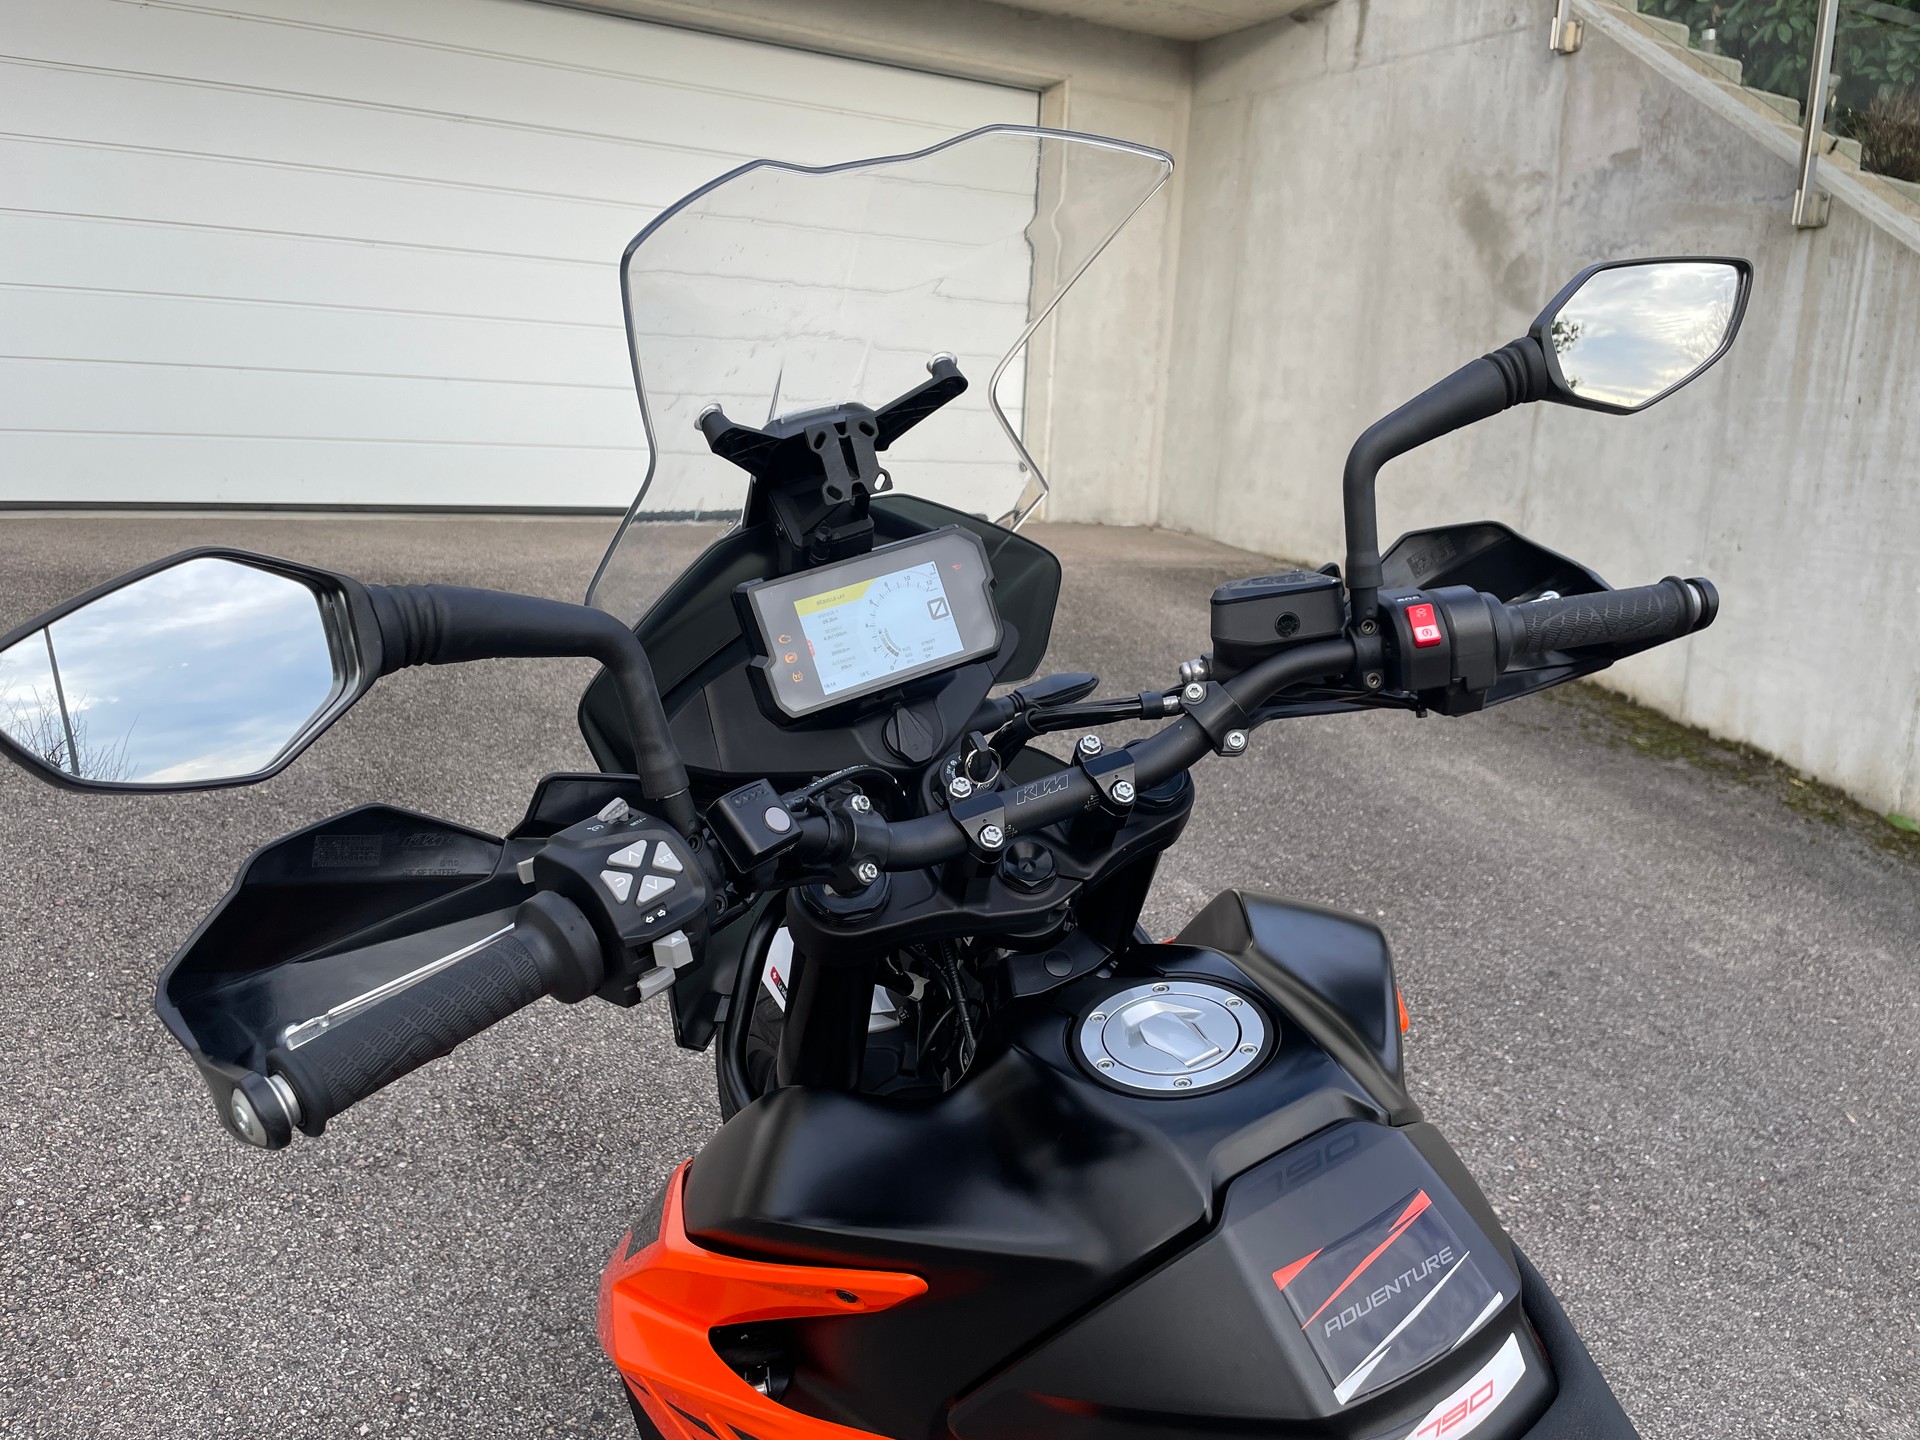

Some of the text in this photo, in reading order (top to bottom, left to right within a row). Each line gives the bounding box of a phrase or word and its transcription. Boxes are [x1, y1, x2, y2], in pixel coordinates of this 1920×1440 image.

[1016, 774, 1069, 805] KTM
[658, 853, 673, 863] SET
[1416, 1379, 1494, 1438] 790
